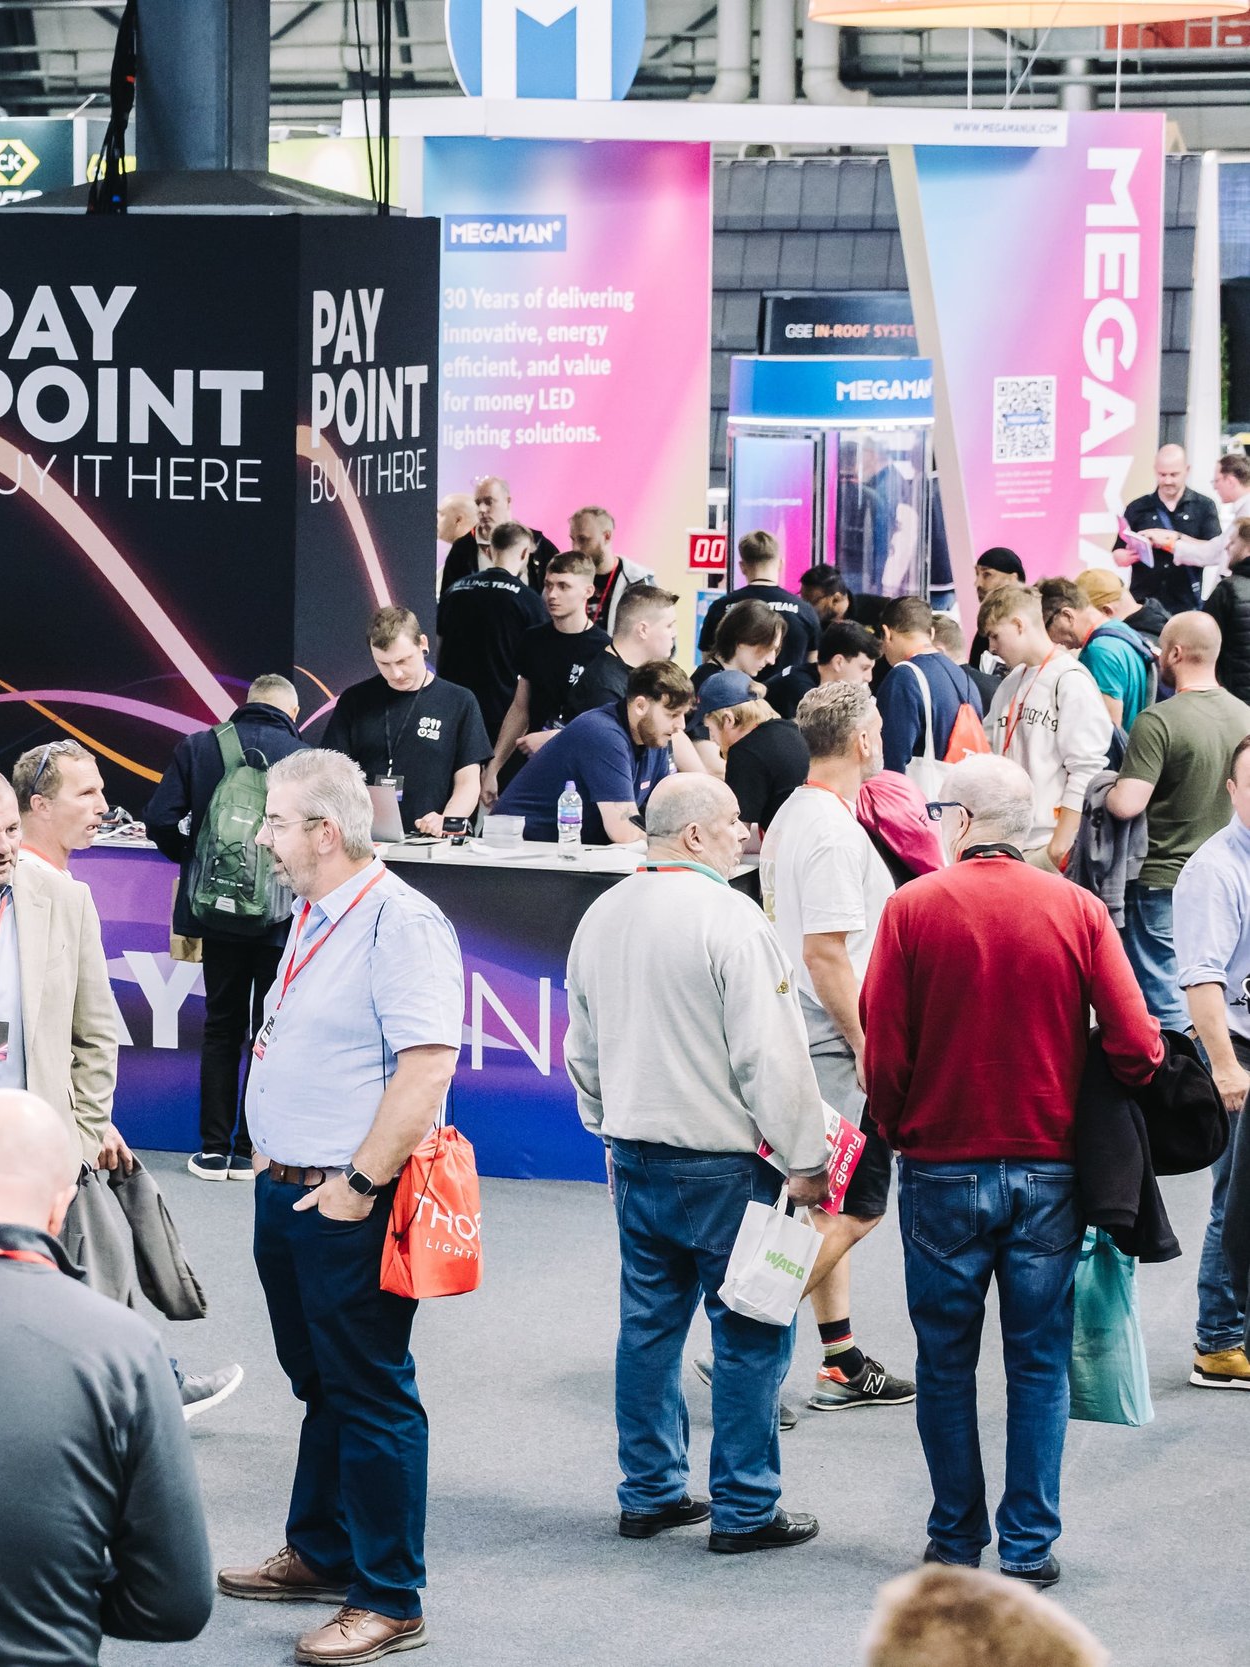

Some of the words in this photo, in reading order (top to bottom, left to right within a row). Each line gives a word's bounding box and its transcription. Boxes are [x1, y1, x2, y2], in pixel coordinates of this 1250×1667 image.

[451, 221, 554, 243] MEGAMAN
[443, 288, 467, 310] 30
[472, 287, 519, 309] Years
[524, 287, 543, 308] of
[547, 286, 634, 312] delivering
[312, 288, 384, 366] PAY
[443, 322, 543, 346] innovative,
[547, 325, 608, 347] energy
[785, 323, 813, 339] GSE
[814, 323, 870, 338] IN-ROOF
[873, 323, 917, 338] SYSTE
[443, 356, 523, 380] efficient,
[527, 354, 560, 376] and
[564, 353, 611, 376] value
[311, 365, 428, 449] POINT
[443, 390, 469, 412] for
[474, 393, 534, 414] money
[538, 387, 575, 410] LED
[443, 423, 511, 450] lighting
[515, 422, 601, 444] solutions.
[73, 454, 112, 498] IT
[127, 456, 262, 502] HERE
[310, 456, 353, 504] BUY
[357, 454, 374, 498] IT
[377, 448, 427, 495] HERE
[492, 581, 521, 594] TEAM
[863, 1372, 886, 1395] N
